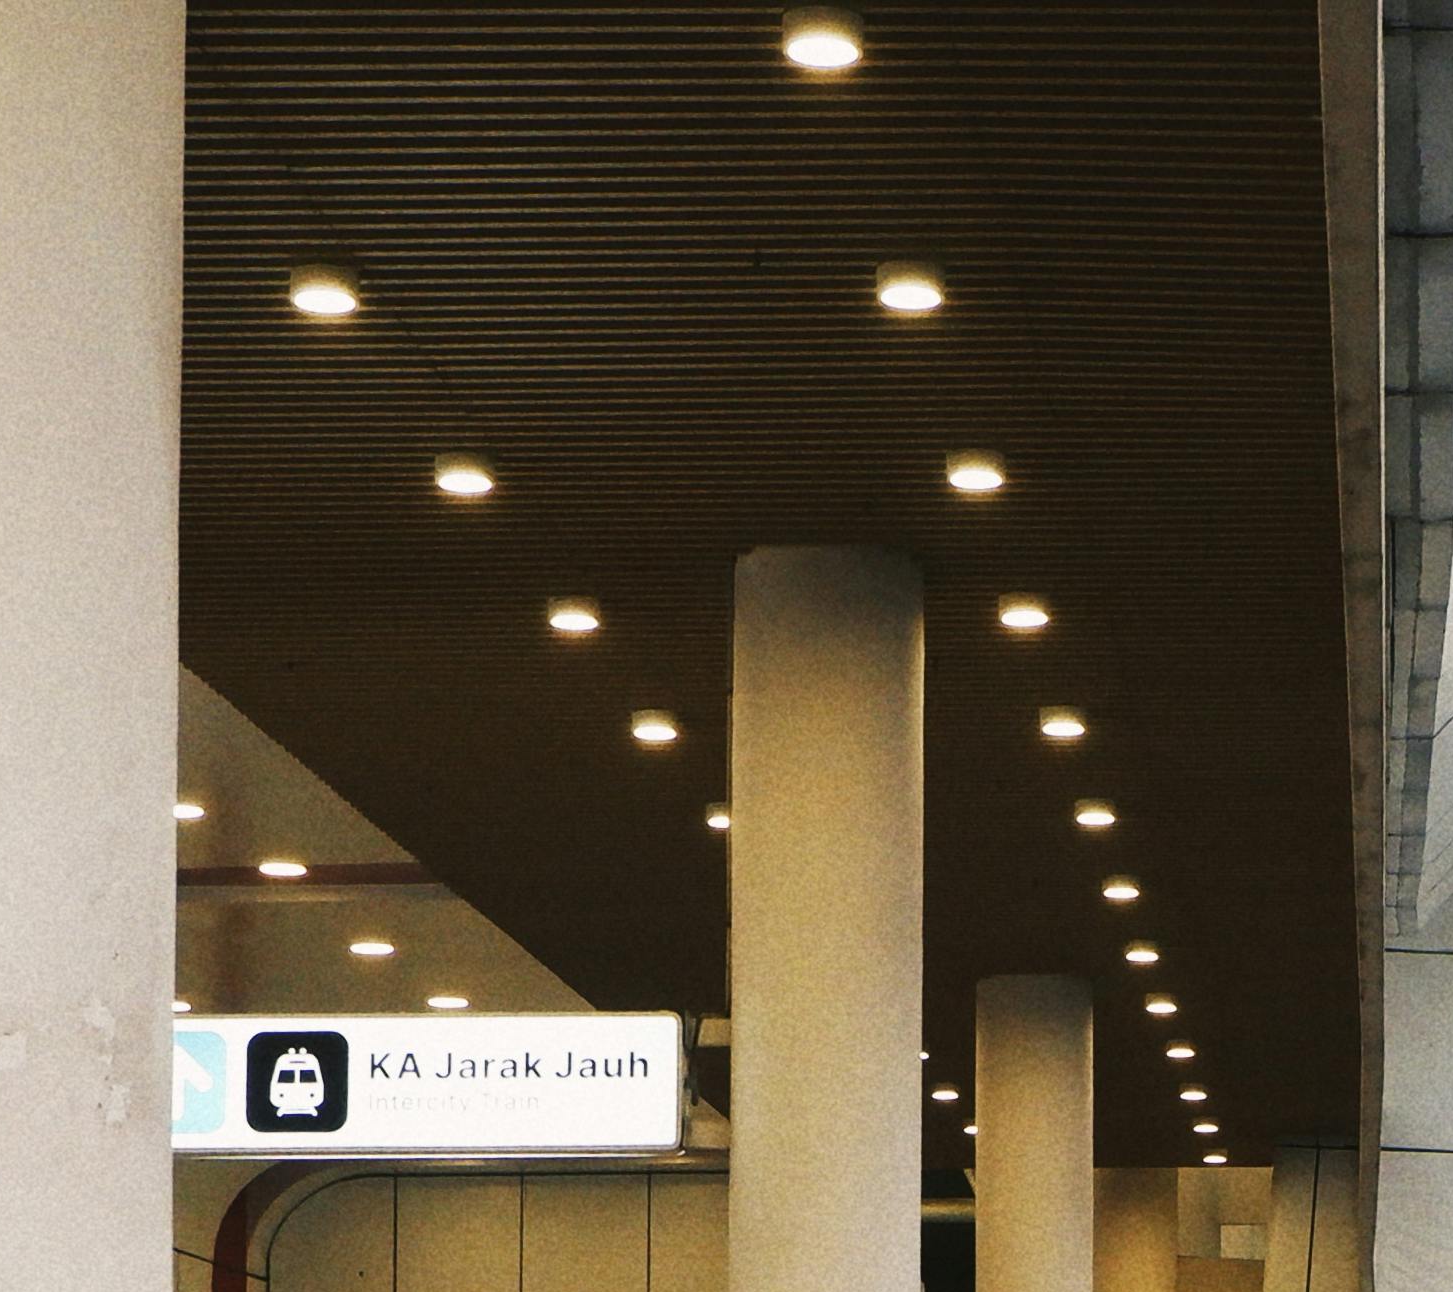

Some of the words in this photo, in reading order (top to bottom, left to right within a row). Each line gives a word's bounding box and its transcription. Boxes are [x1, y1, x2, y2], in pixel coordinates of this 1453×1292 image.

[370, 1053, 421, 1079] KA
[435, 1052, 542, 1079] Jarak
[555, 1051, 648, 1079] Jauh
[368, 1094, 471, 1112] Intercity
